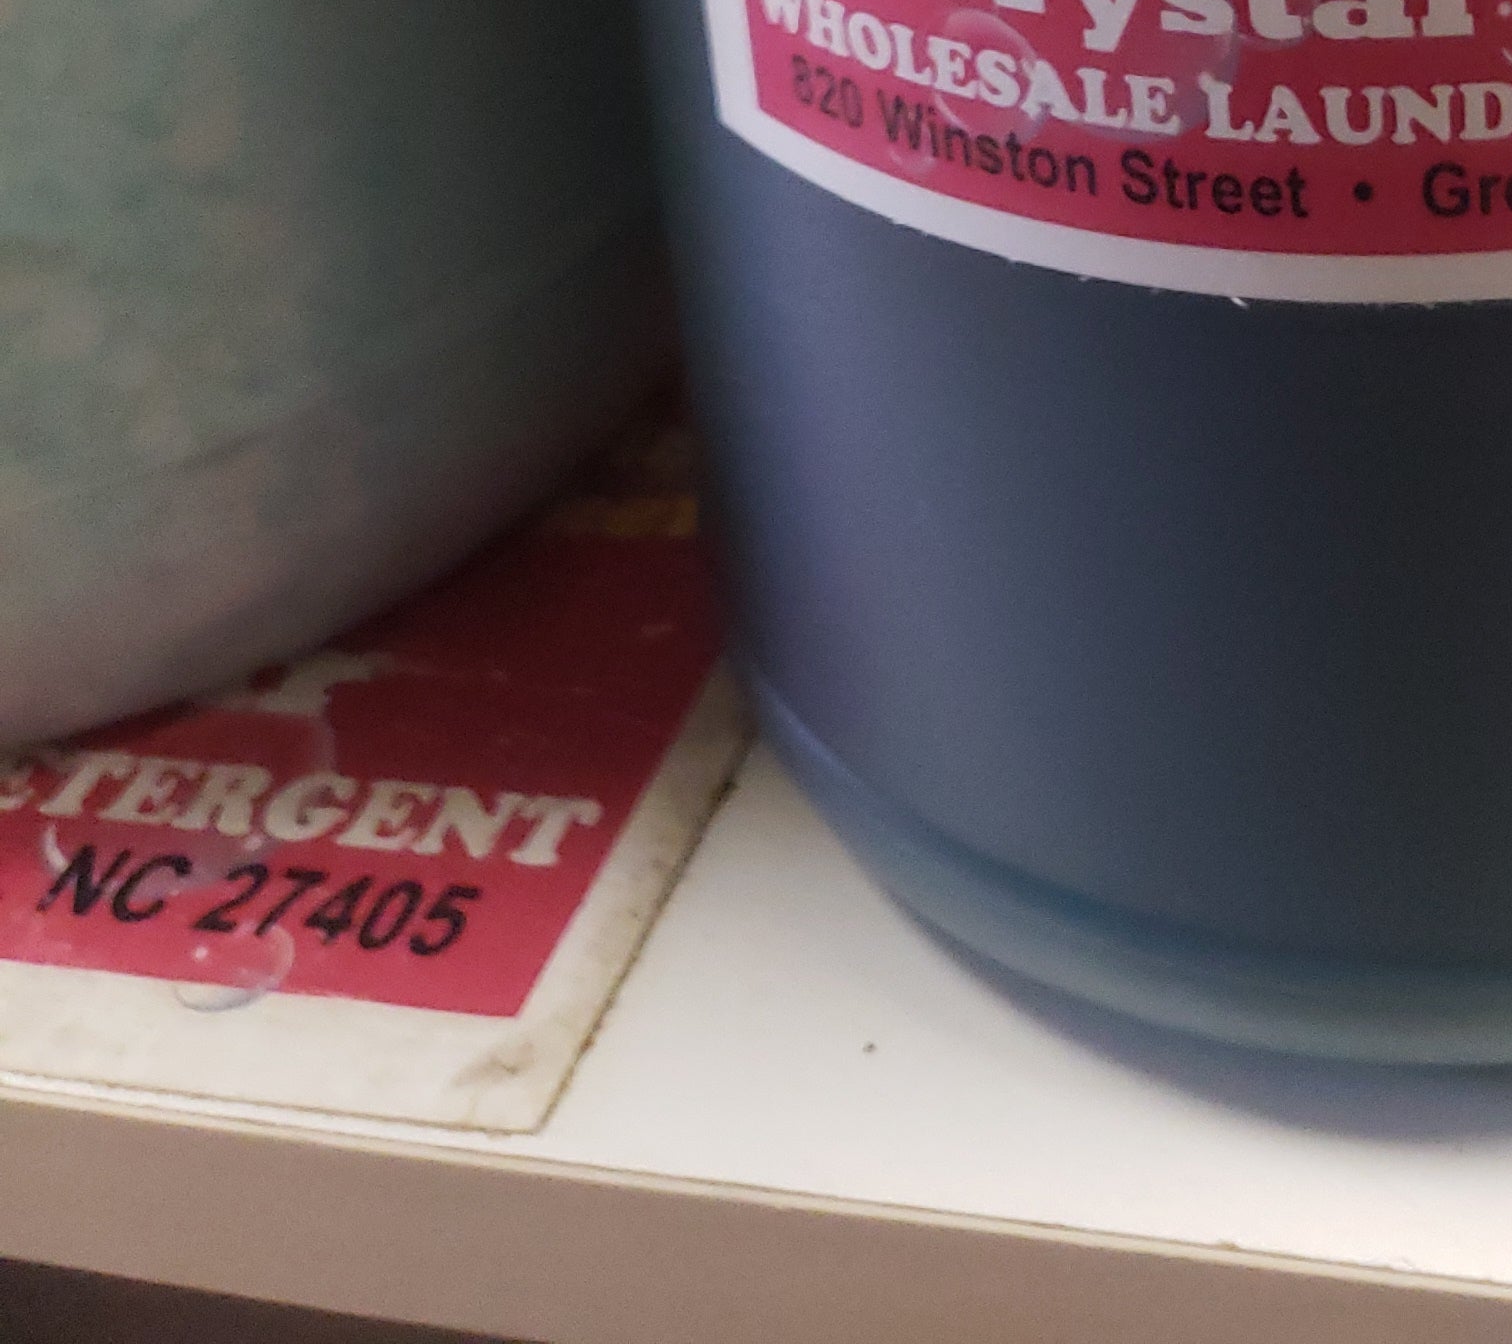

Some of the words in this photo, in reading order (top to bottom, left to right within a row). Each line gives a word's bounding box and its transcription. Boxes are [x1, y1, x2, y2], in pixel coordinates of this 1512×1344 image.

[791, 54, 865, 129] 820
[877, 89, 1098, 195] Winston
[1121, 148, 1310, 218] Street
[37, 844, 190, 924] NC
[194, 861, 482, 958] 27405
